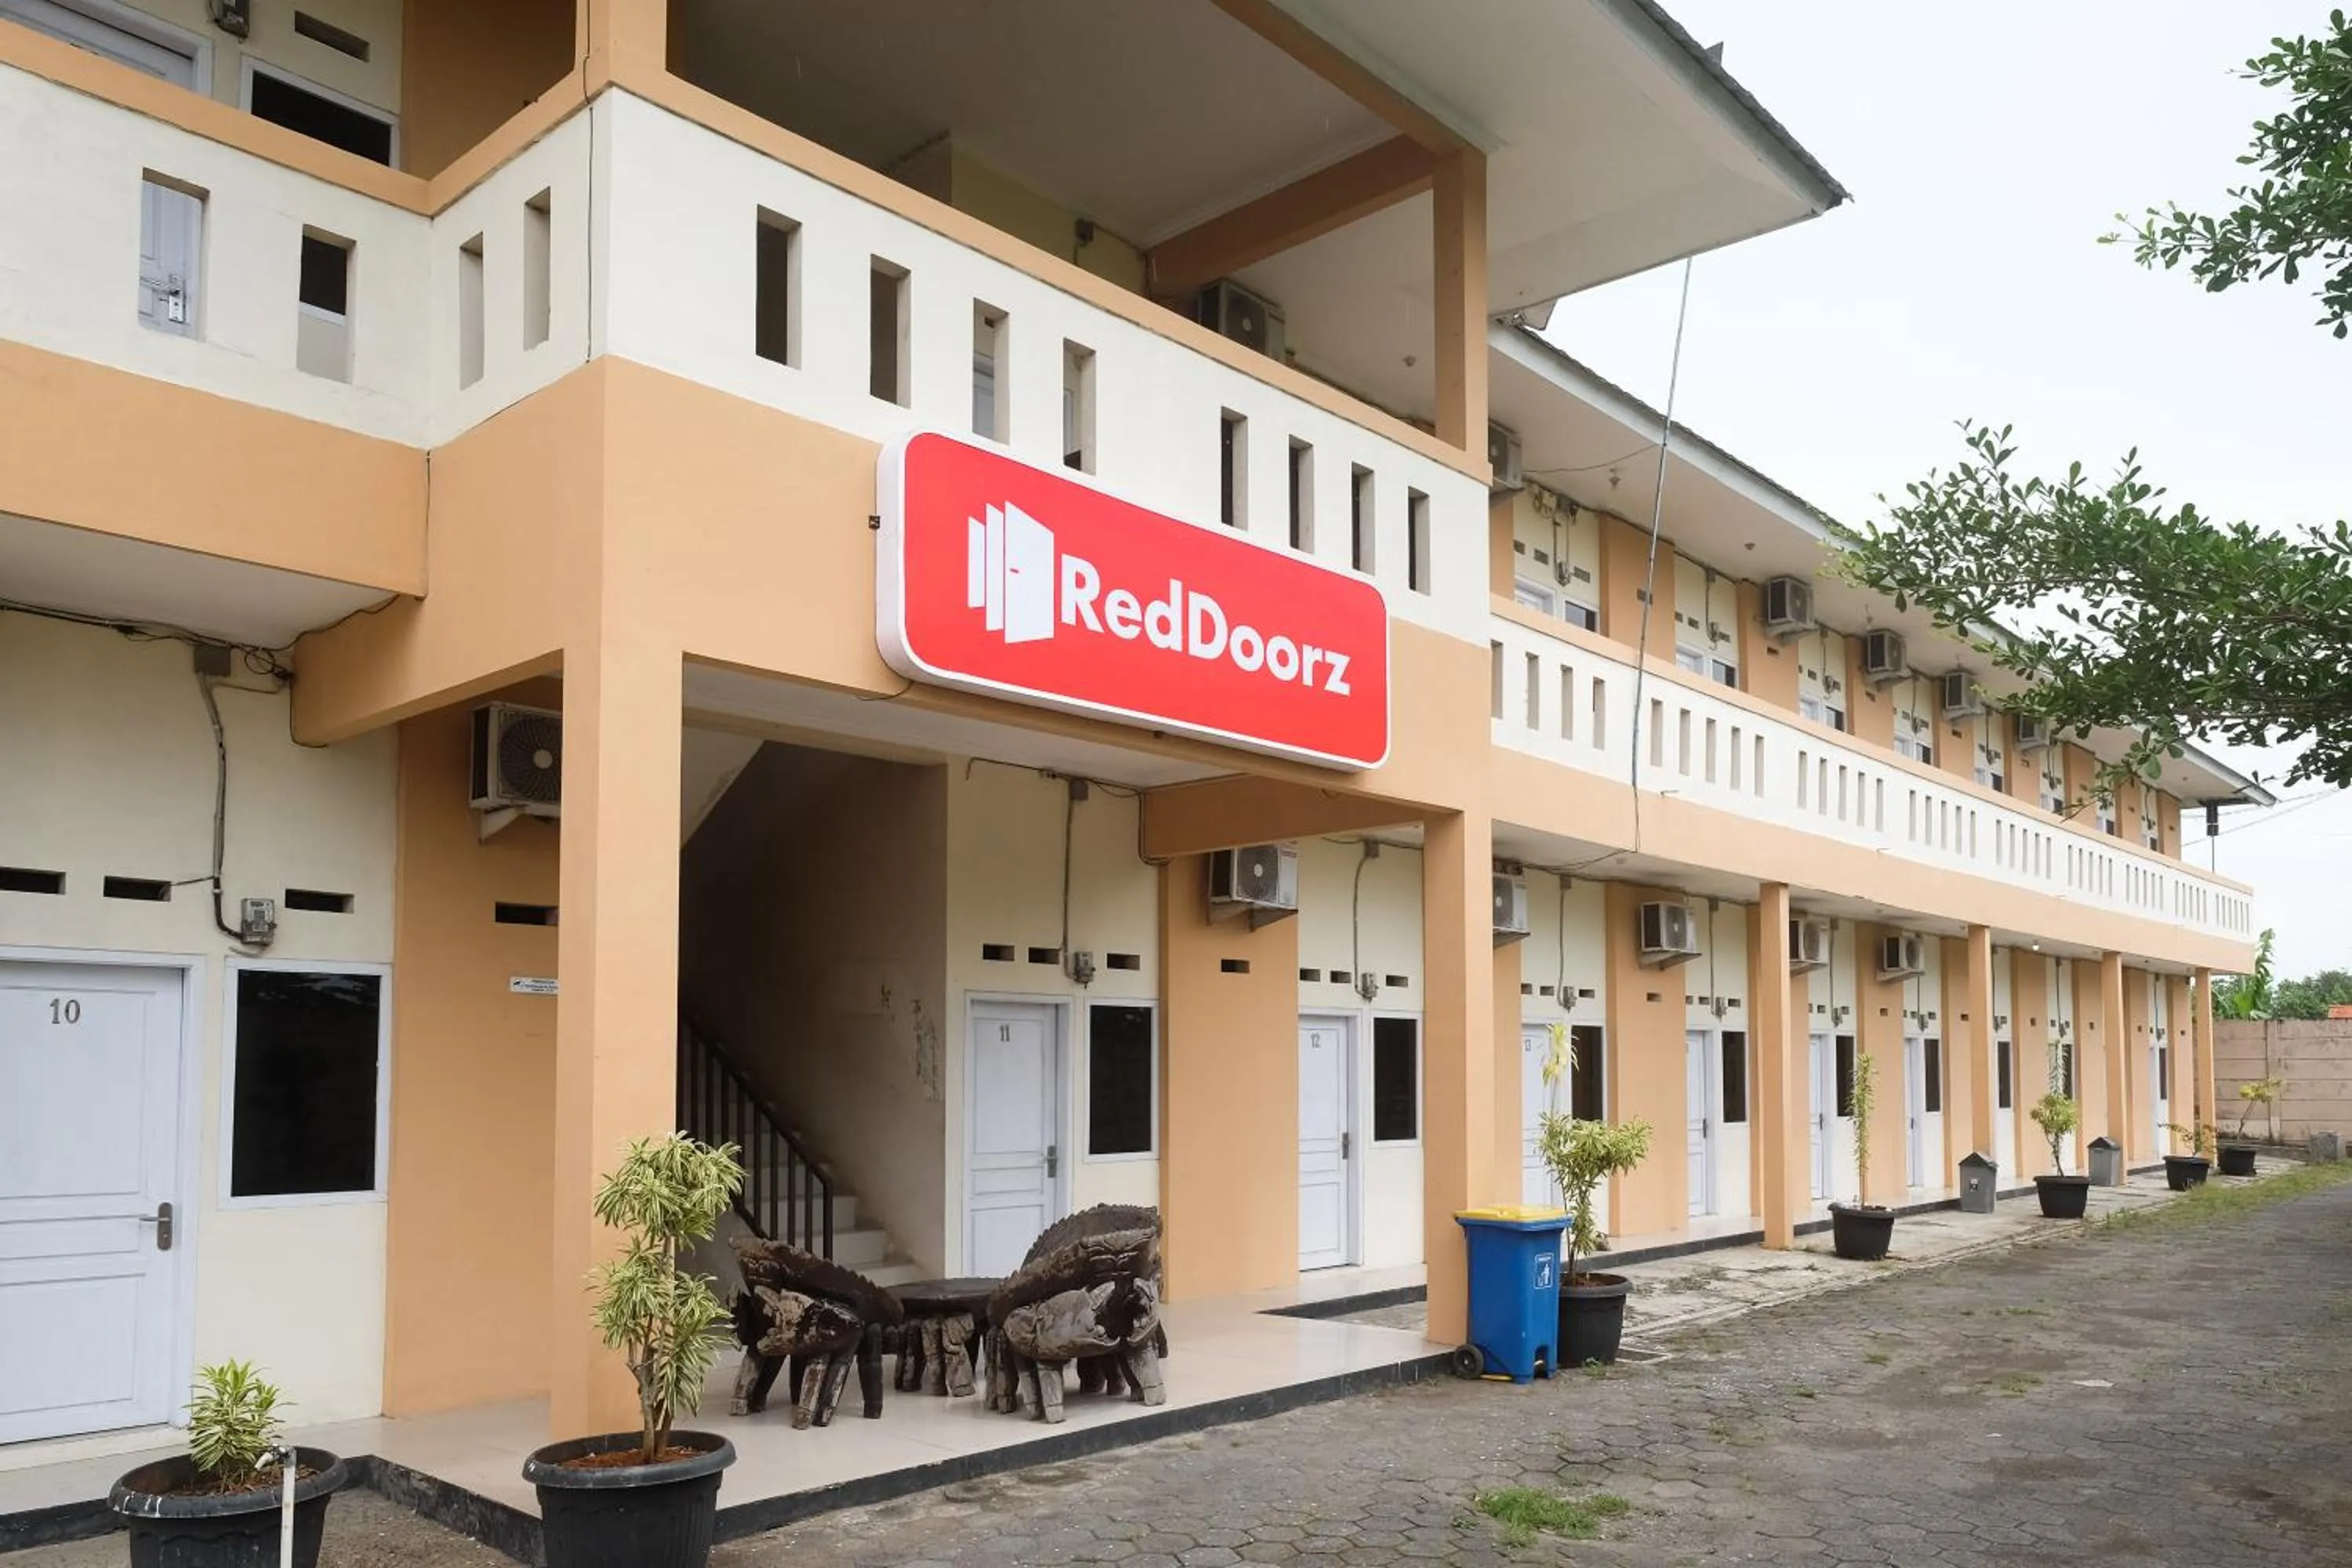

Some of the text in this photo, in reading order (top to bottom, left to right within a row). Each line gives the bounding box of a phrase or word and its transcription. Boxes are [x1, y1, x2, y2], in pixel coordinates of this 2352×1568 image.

[1061, 554, 1350, 696] RedDoorz
[49, 998, 81, 1024] 10
[999, 1023, 1011, 1042] 11
